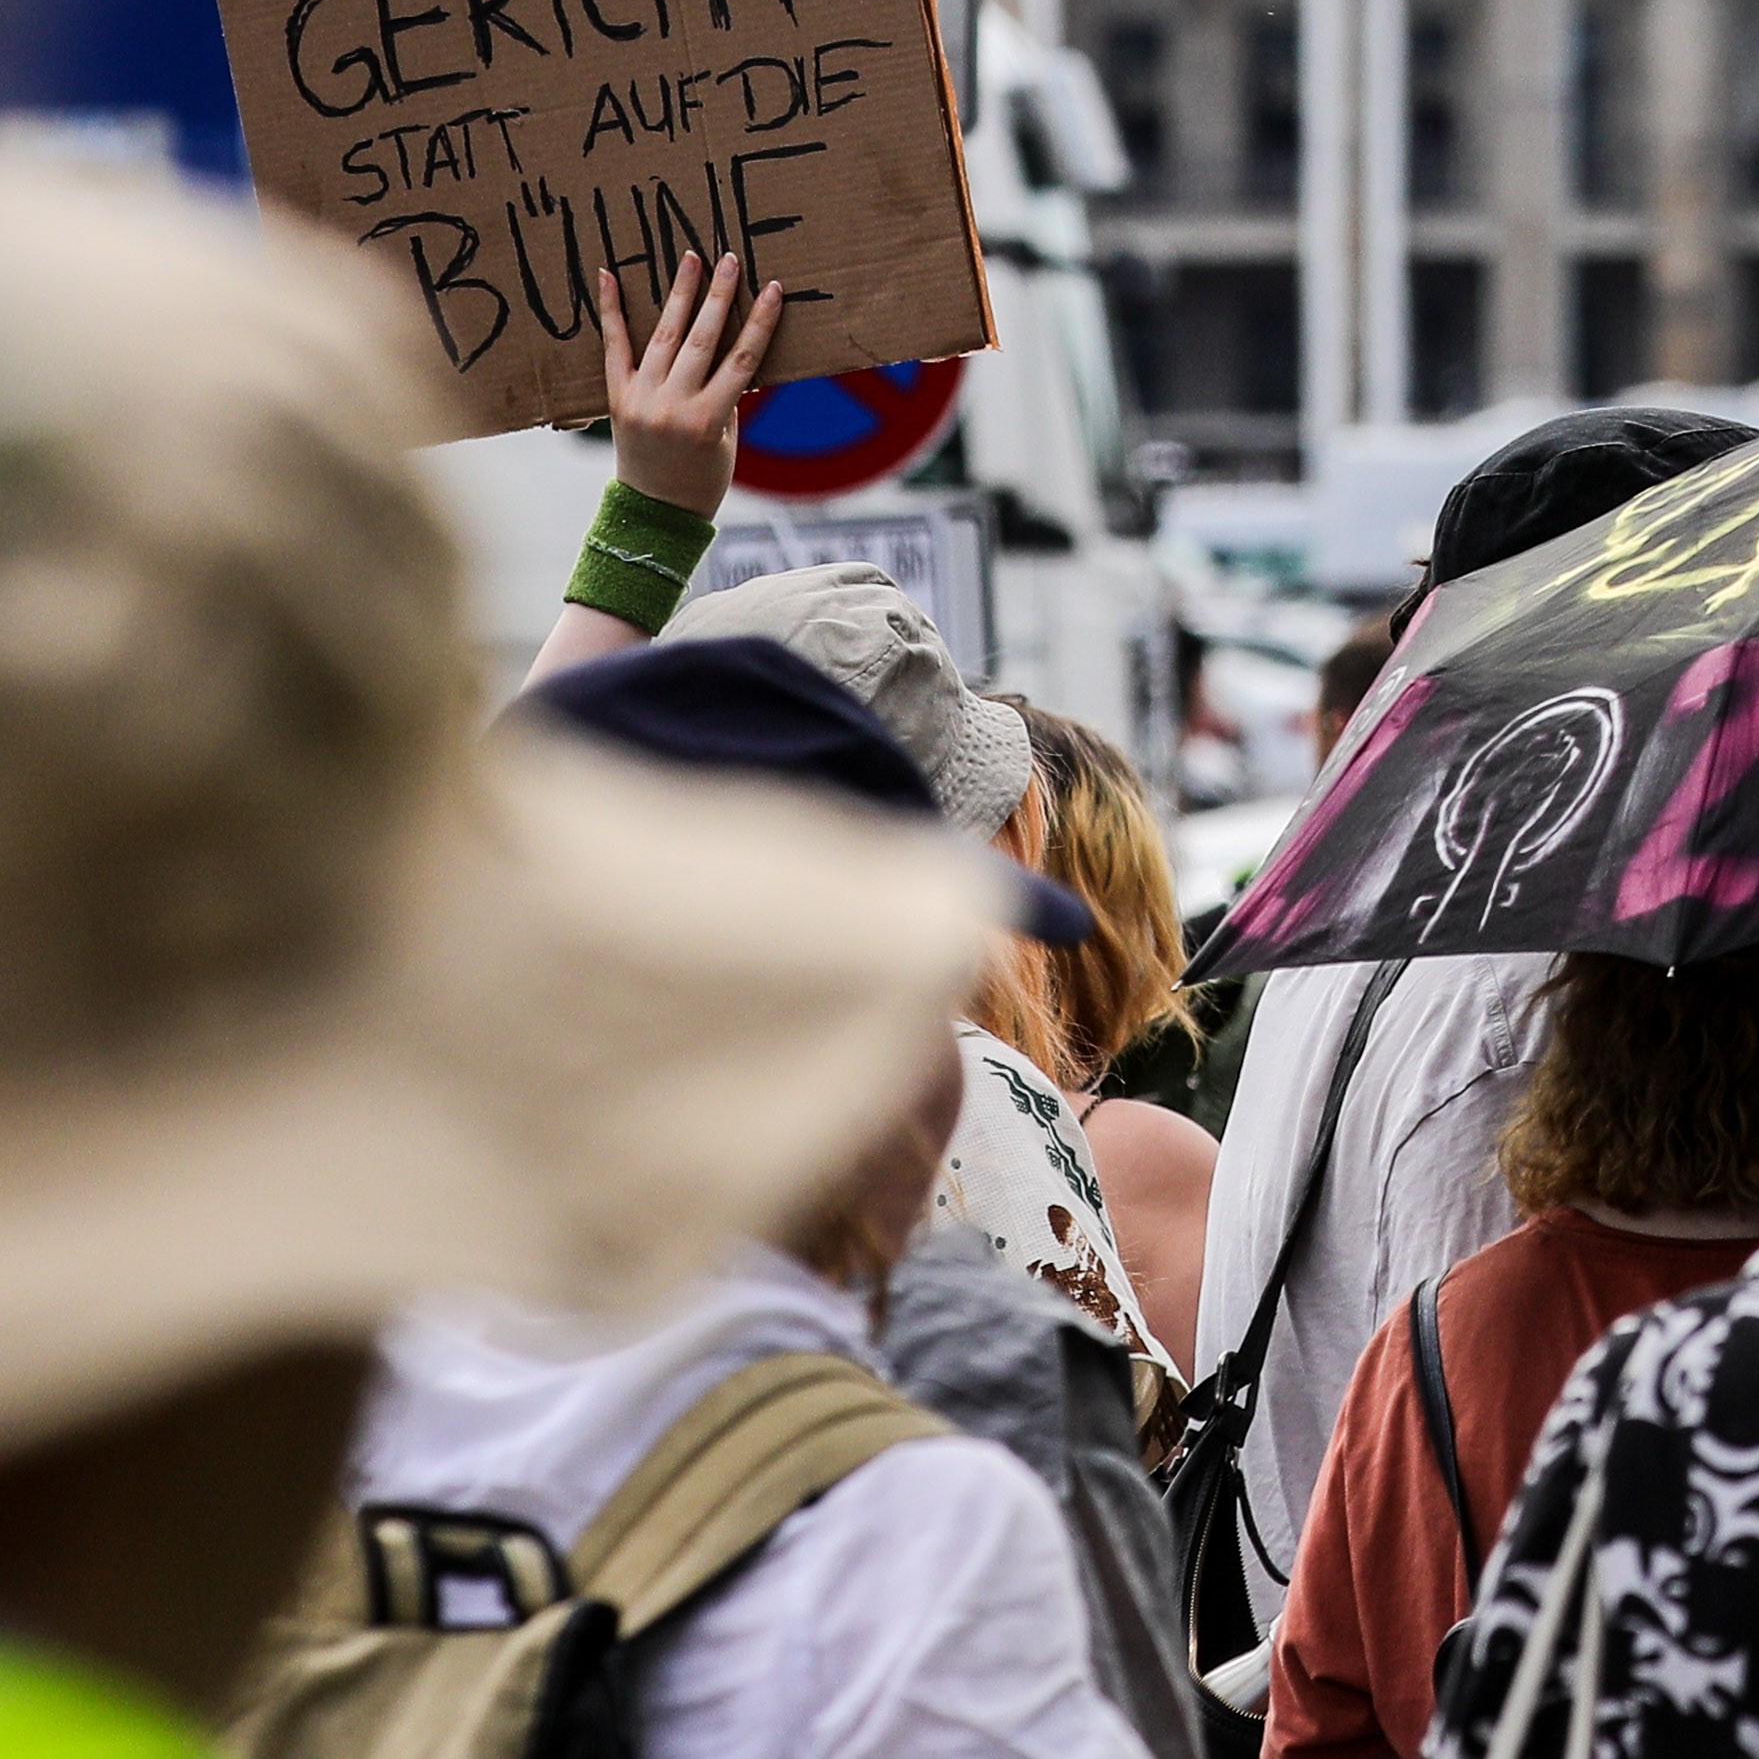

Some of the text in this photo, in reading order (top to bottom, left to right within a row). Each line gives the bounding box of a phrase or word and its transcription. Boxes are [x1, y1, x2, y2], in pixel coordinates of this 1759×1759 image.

[341, 38, 893, 207] STATT AUF DIE
[358, 141, 835, 375] BÜHNE
